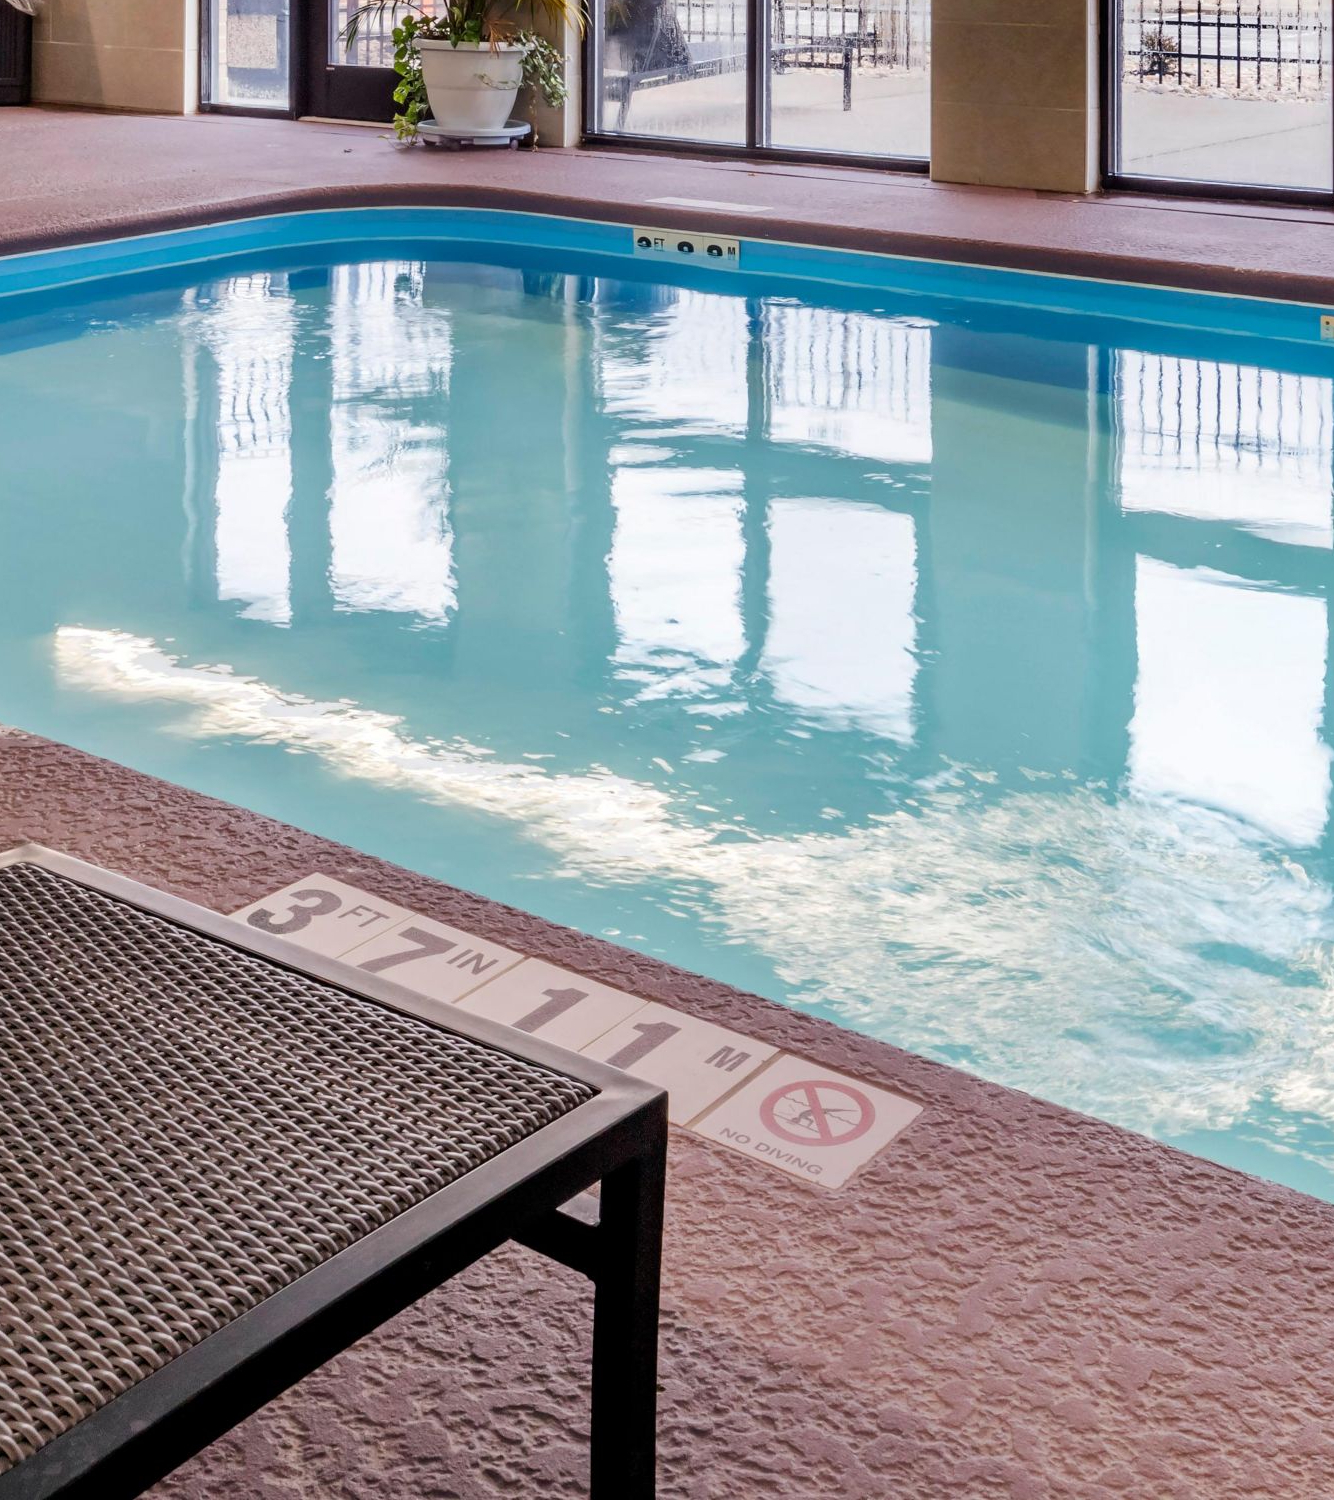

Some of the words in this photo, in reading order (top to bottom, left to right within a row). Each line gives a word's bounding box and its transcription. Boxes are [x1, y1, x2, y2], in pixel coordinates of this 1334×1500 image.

[728, 247, 736, 256] M
[246, 889, 342, 934] 3
[337, 905, 390, 927] FT
[356, 927, 458, 973] 7
[447, 949, 499, 976] IN
[704, 1046, 751, 1071] M
[719, 1128, 751, 1148] NO
[755, 1142, 823, 1176] DIVING
